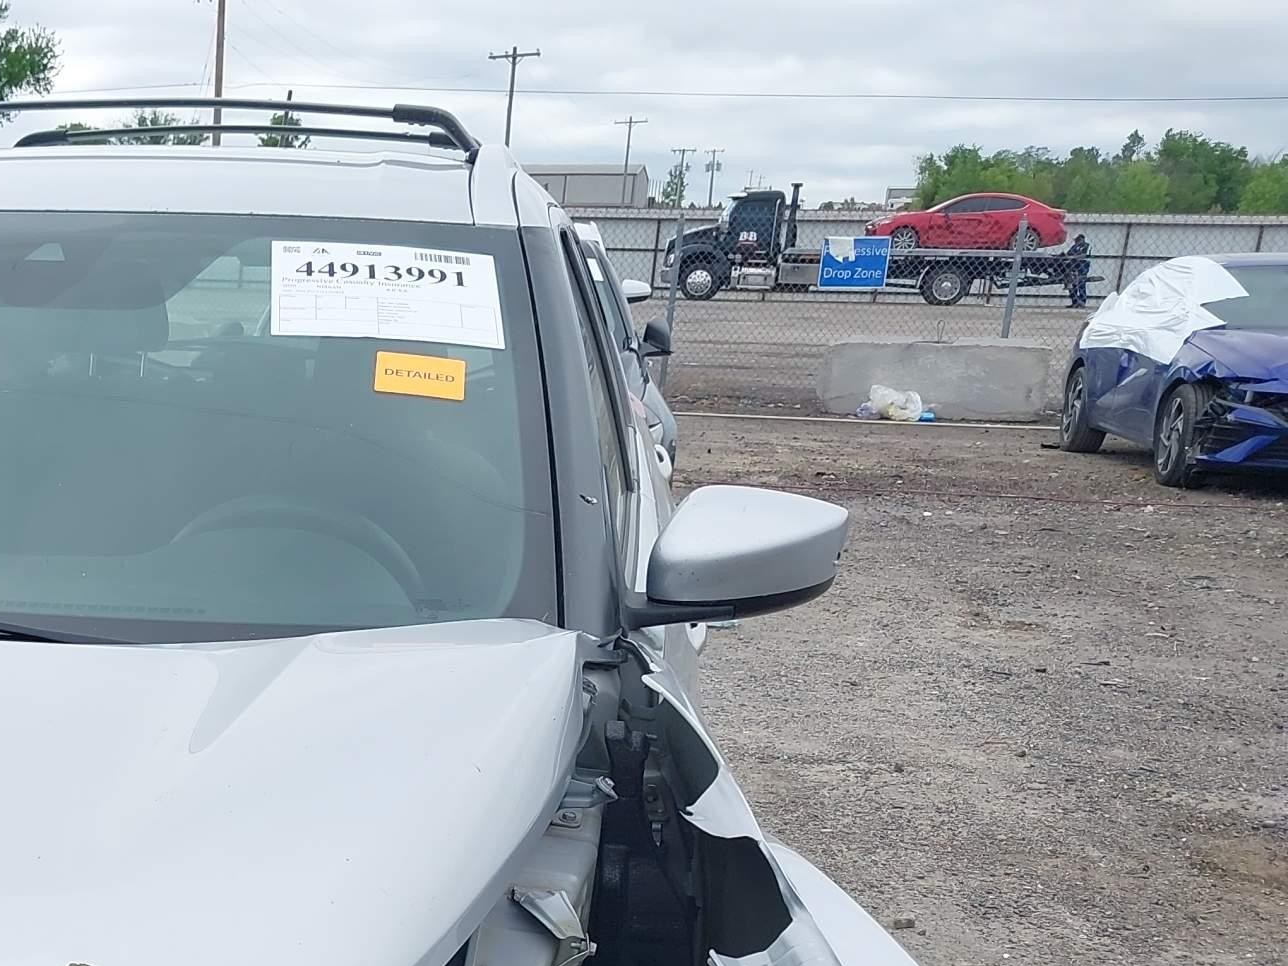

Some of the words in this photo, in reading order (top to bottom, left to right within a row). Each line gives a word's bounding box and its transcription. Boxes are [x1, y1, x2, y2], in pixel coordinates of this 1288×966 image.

[823, 244, 889, 257] Pessive
[295, 261, 469, 288] 44913991
[823, 267, 852, 280] Drop
[853, 267, 882, 279] Zone
[384, 368, 455, 383] DETAILED
